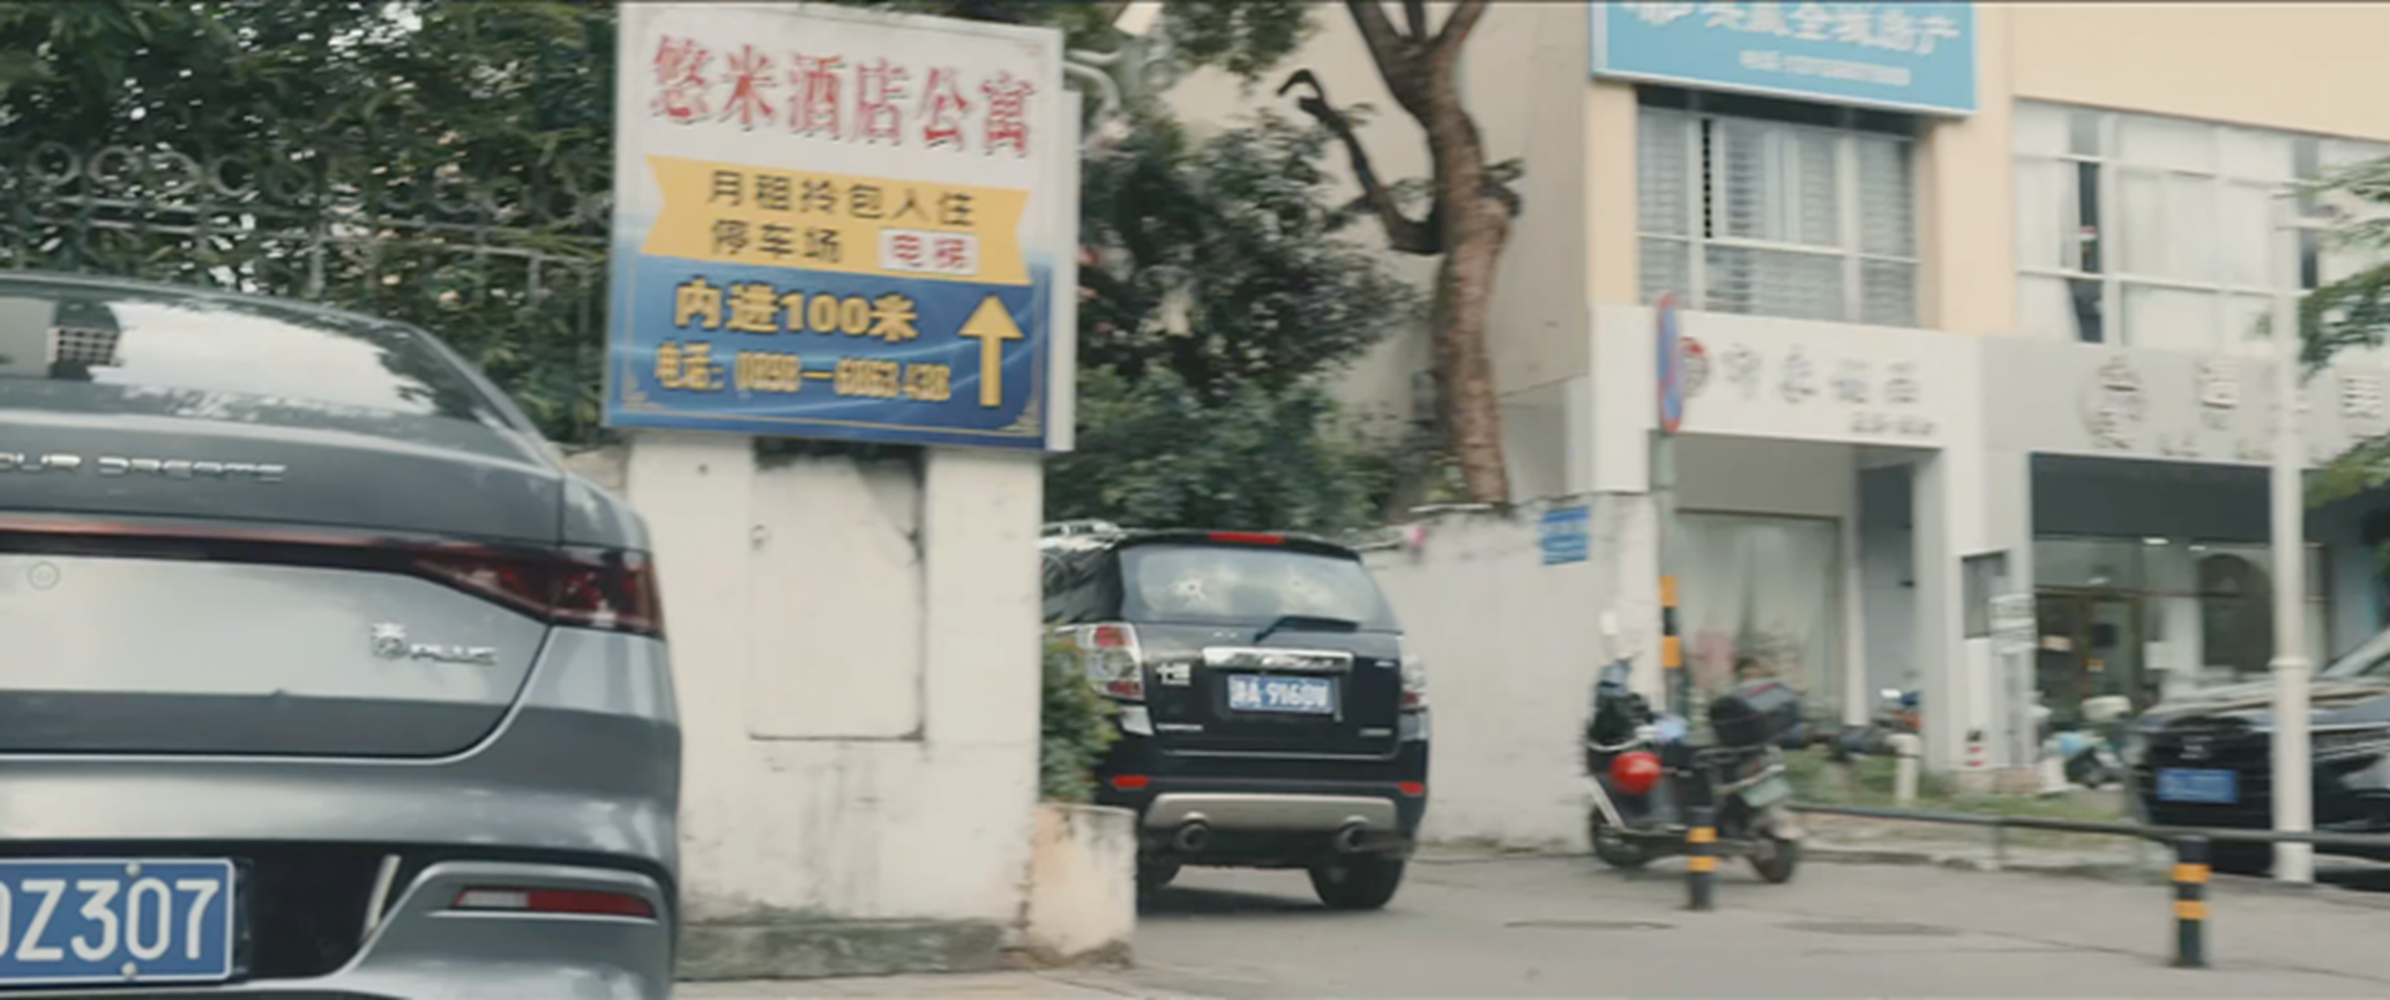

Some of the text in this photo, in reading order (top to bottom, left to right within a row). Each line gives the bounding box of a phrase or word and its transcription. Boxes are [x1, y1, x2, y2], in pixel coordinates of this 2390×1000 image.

[651, 35, 1034, 157] 悠米酒店公寓
[708, 169, 975, 227] 月租拎包入住
[710, 218, 968, 270] 停车场 电梯
[673, 274, 919, 343] 内进100米
[97, 455, 287, 483] DREAMS
[408, 643, 499, 667] PLUS
[0, 876, 220, 962] Z307
